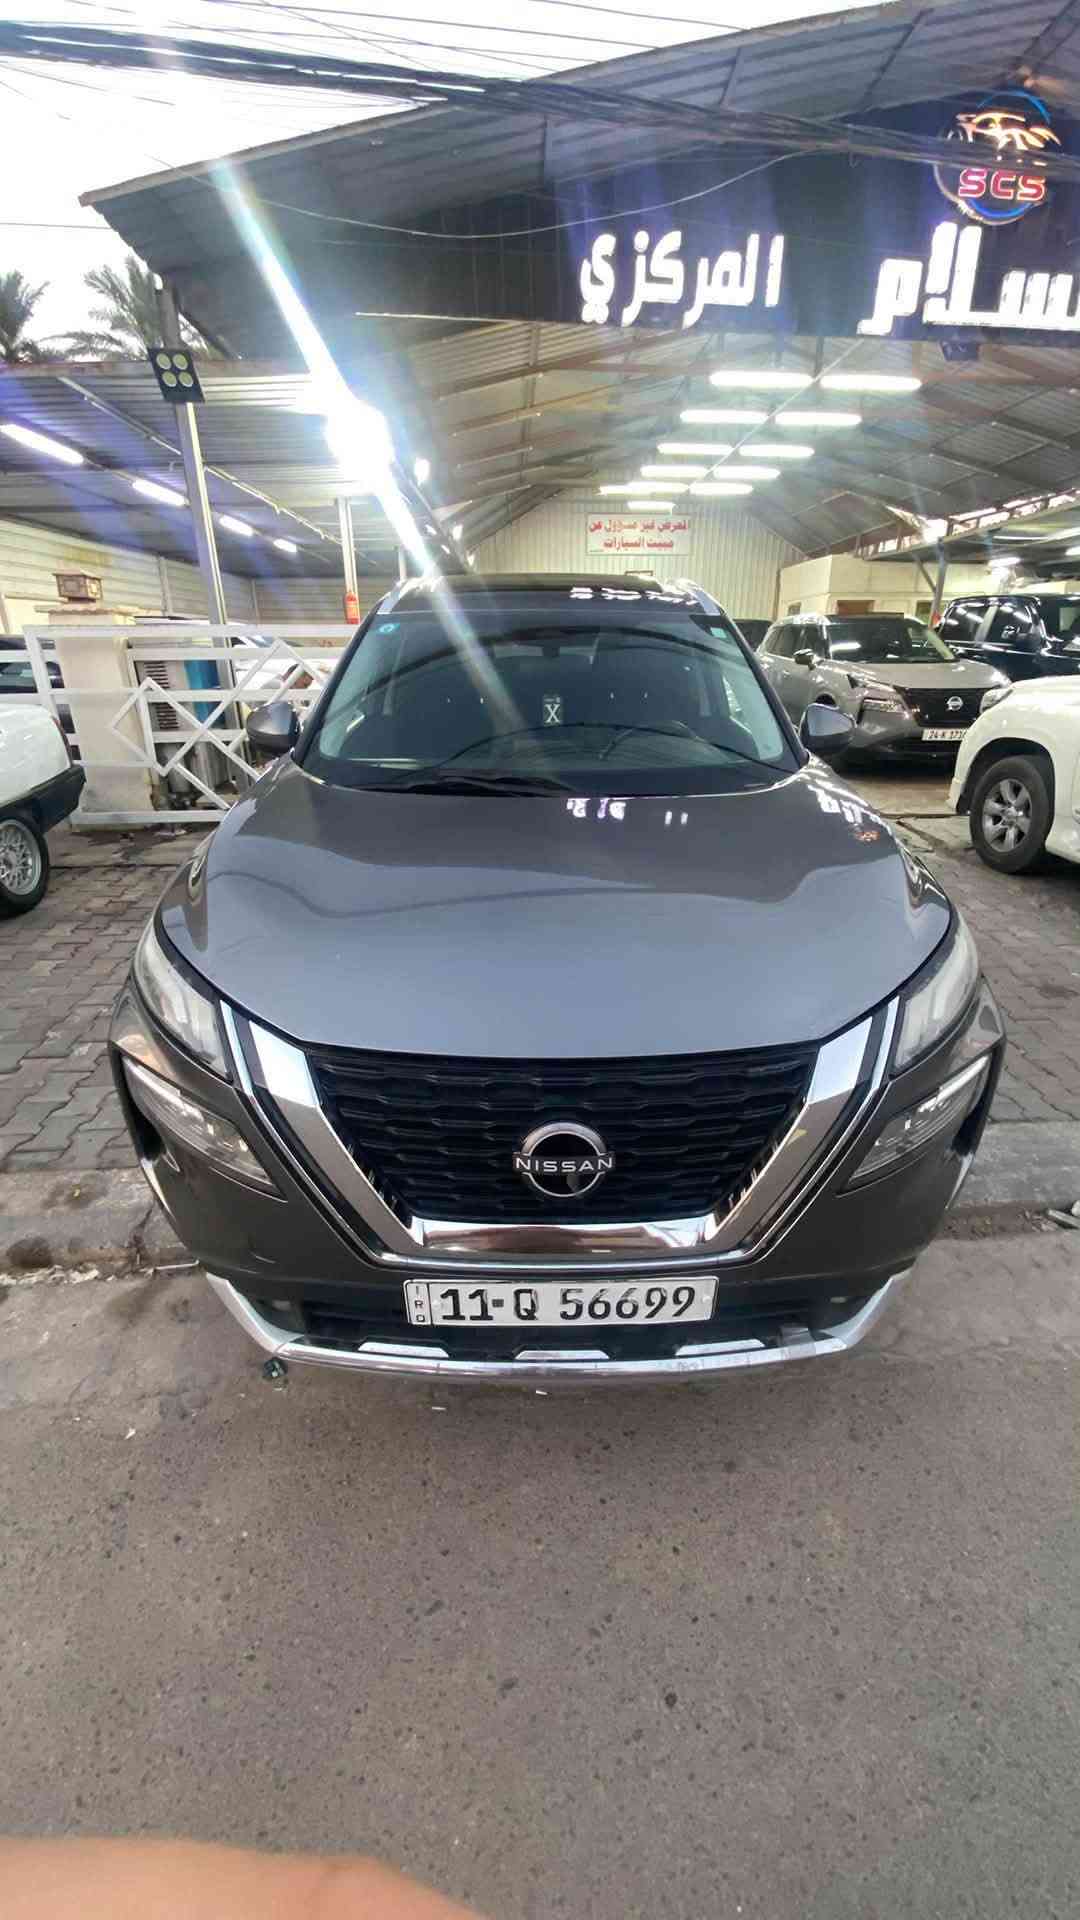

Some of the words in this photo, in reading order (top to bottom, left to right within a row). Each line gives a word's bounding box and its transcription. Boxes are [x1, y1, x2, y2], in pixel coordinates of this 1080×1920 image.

[958, 167, 1047, 202] SCS
[579, 229, 785, 329] المركزي
[856, 221, 1080, 336] سلام
[588, 520, 602, 533] عن
[639, 518, 655, 534] غير
[603, 536, 645, 552] السيارات
[515, 1157, 613, 1173] NISSAN
[439, 1288, 538, 1321] 11-Q
[559, 1286, 696, 1320] 56699
